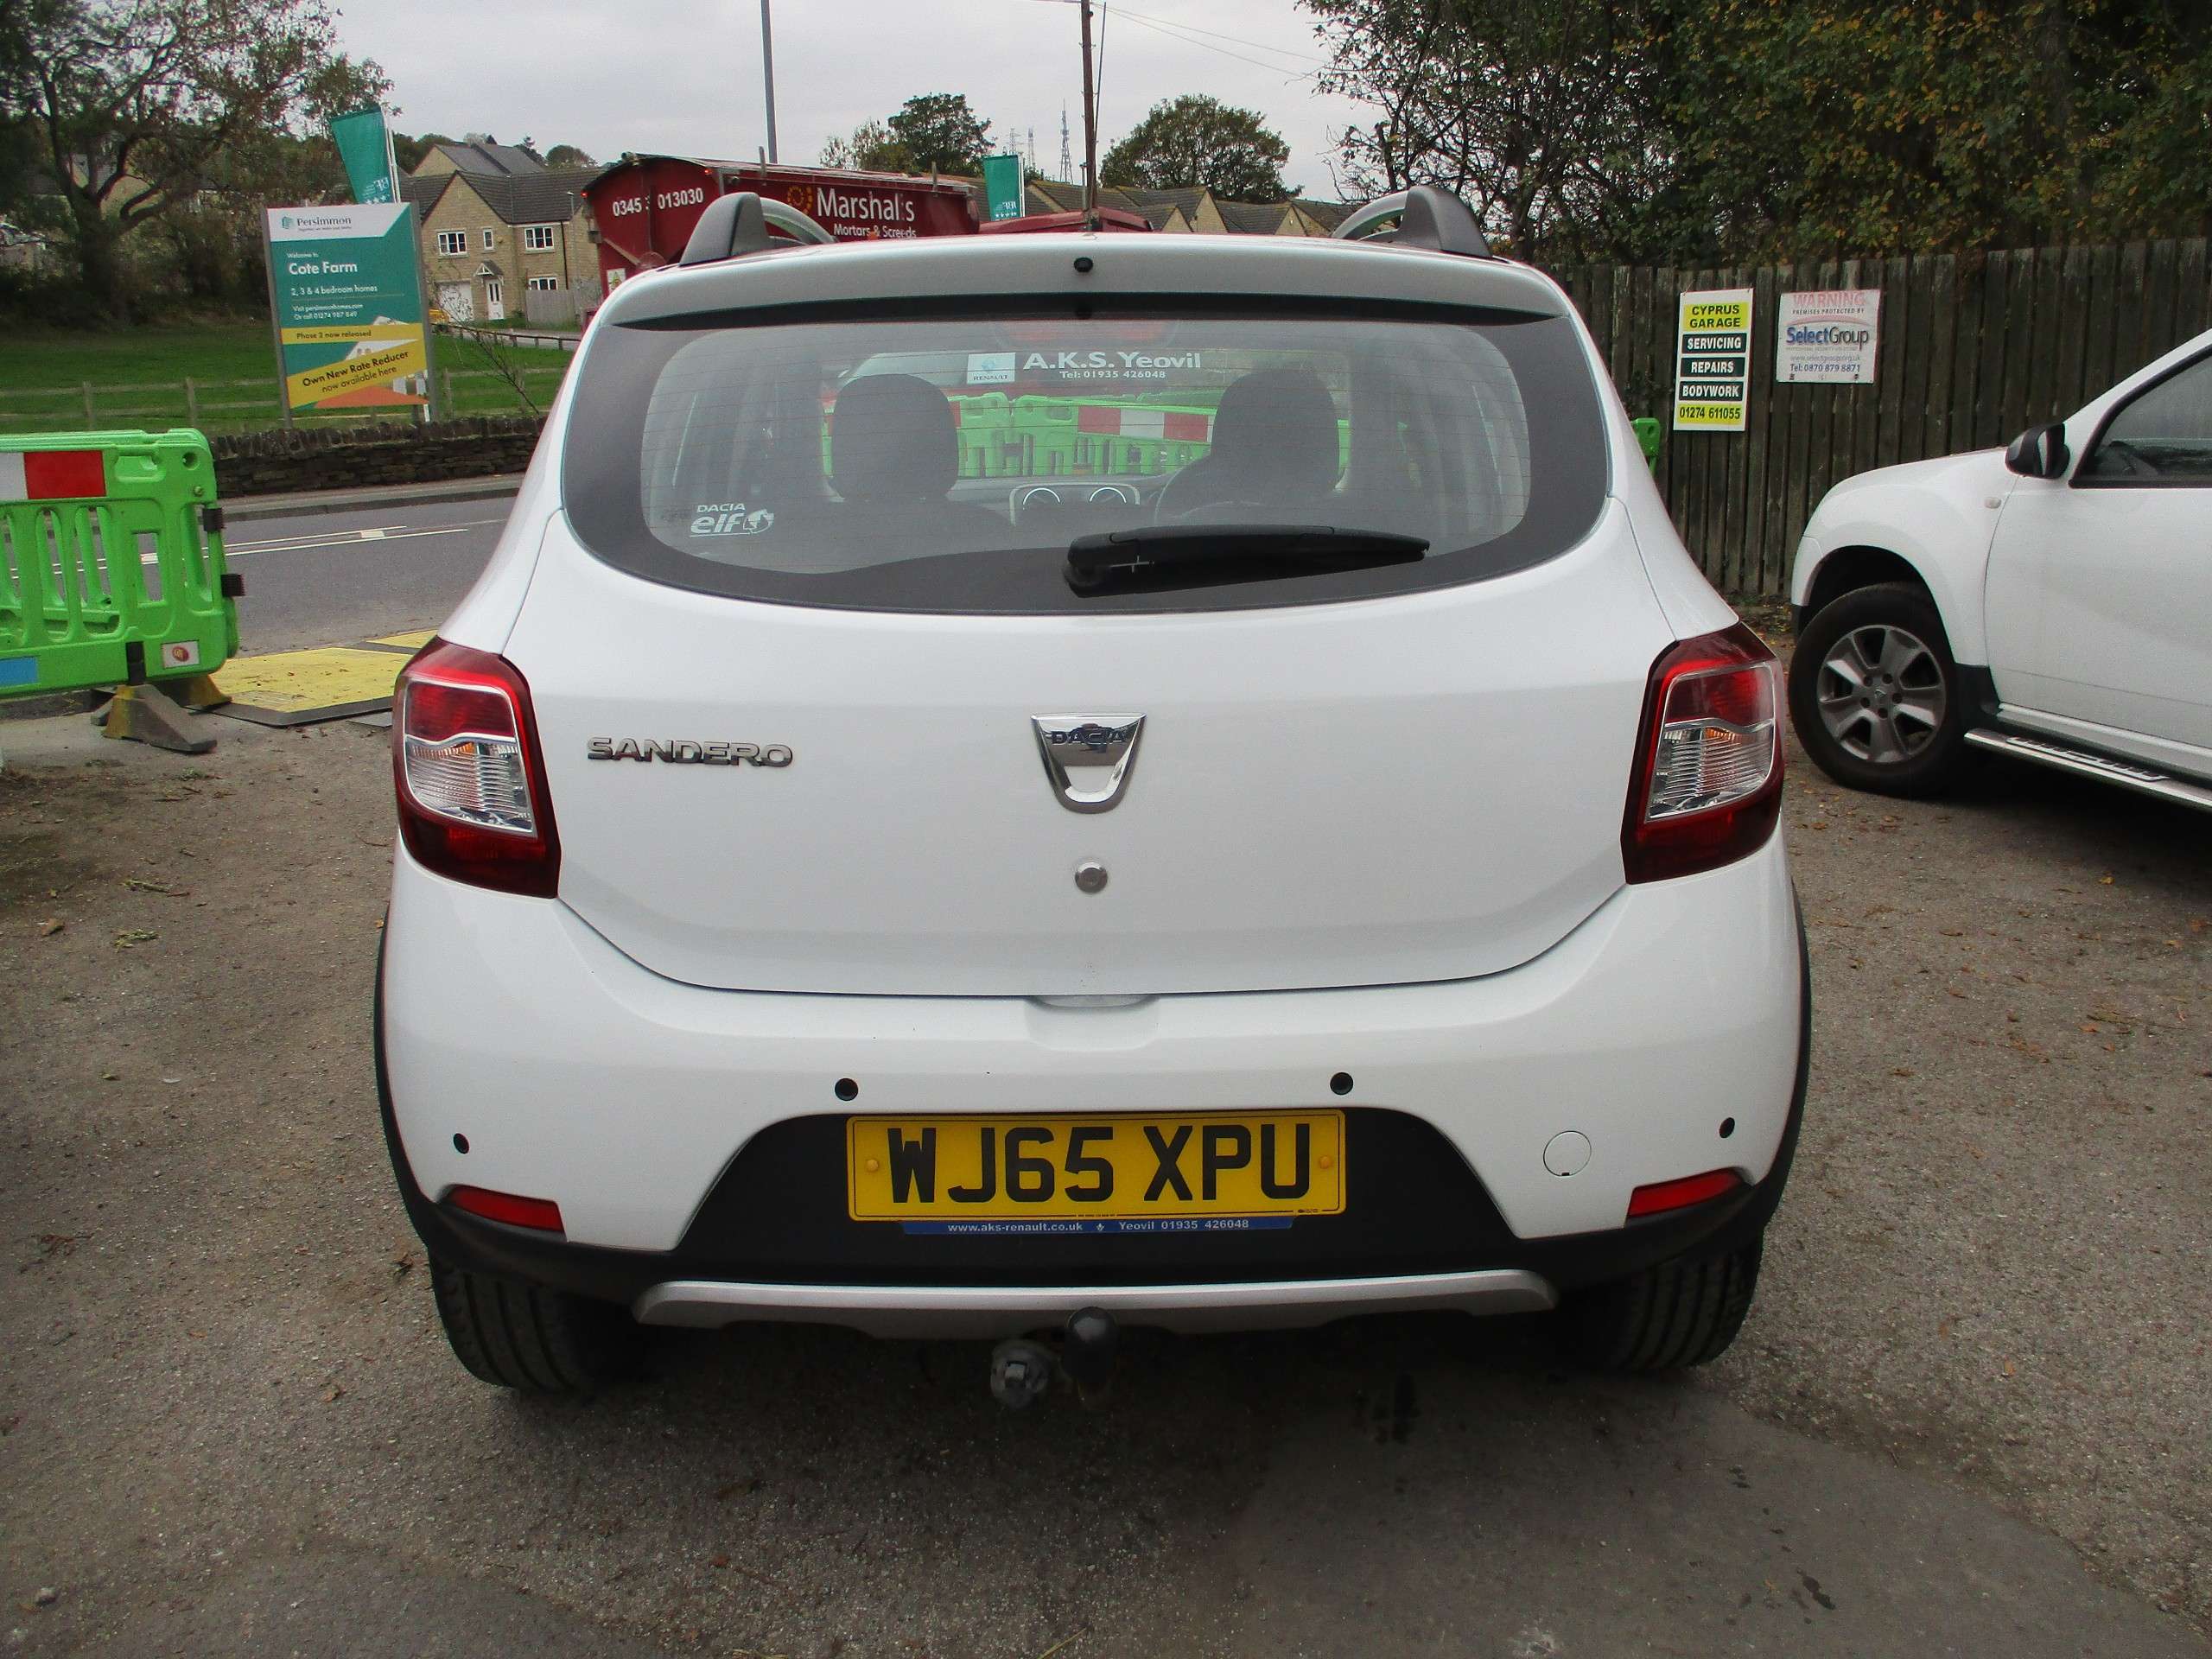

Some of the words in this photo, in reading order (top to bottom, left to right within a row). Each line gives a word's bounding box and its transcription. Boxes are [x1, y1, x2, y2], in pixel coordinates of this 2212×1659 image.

[612, 197, 643, 217] 0345
[817, 187, 915, 222] Marshals
[296, 216, 352, 226] Persimmon
[833, 223, 871, 238] Mortars
[882, 226, 917, 238] Screeds
[289, 262, 320, 275] Cote
[322, 261, 358, 274] Farm
[291, 288, 299, 296] 2,
[321, 285, 353, 295] bedroom
[1793, 292, 1866, 306] WARNING
[1692, 304, 1740, 315] CYPRUS
[1689, 317, 1741, 329] GARAGE
[1687, 335, 1742, 350] SERVICING
[1786, 326, 1869, 351] SelectGroup
[1023, 352, 1115, 370] A.K.S.
[1117, 352, 1201, 369] Yeovil
[1690, 360, 1734, 373] REPAIRS
[1790, 364, 1803, 372] Tel:
[1804, 364, 1823, 372] 0870
[1825, 364, 1840, 372] 879
[302, 375, 326, 387] Own
[327, 368, 348, 379] New
[350, 360, 372, 374] Rate
[372, 351, 409, 366] Reducer
[1059, 370, 1082, 379] Tel:
[1084, 370, 1119, 378] 01935
[1123, 370, 1166, 378] 426048
[322, 385, 339, 393] now
[340, 371, 378, 388] available
[379, 365, 397, 377] here
[1682, 384, 1739, 398] BODYWORK
[1679, 406, 1706, 419] 01274
[1708, 406, 1741, 420] 611055
[696, 503, 746, 512] DACIA
[690, 512, 745, 534] elf
[1051, 729, 1125, 746] DACIA
[587, 736, 793, 767] SANDERO
[887, 1127, 1114, 1204] WJ65
[1143, 1123, 1310, 1202] XPU
[948, 1221, 1083, 1232] www.aks-renault.co.uk
[1118, 1220, 1154, 1231] Yeovil
[1160, 1220, 1198, 1230] 01935
[1204, 1219, 1249, 1230] 426048
